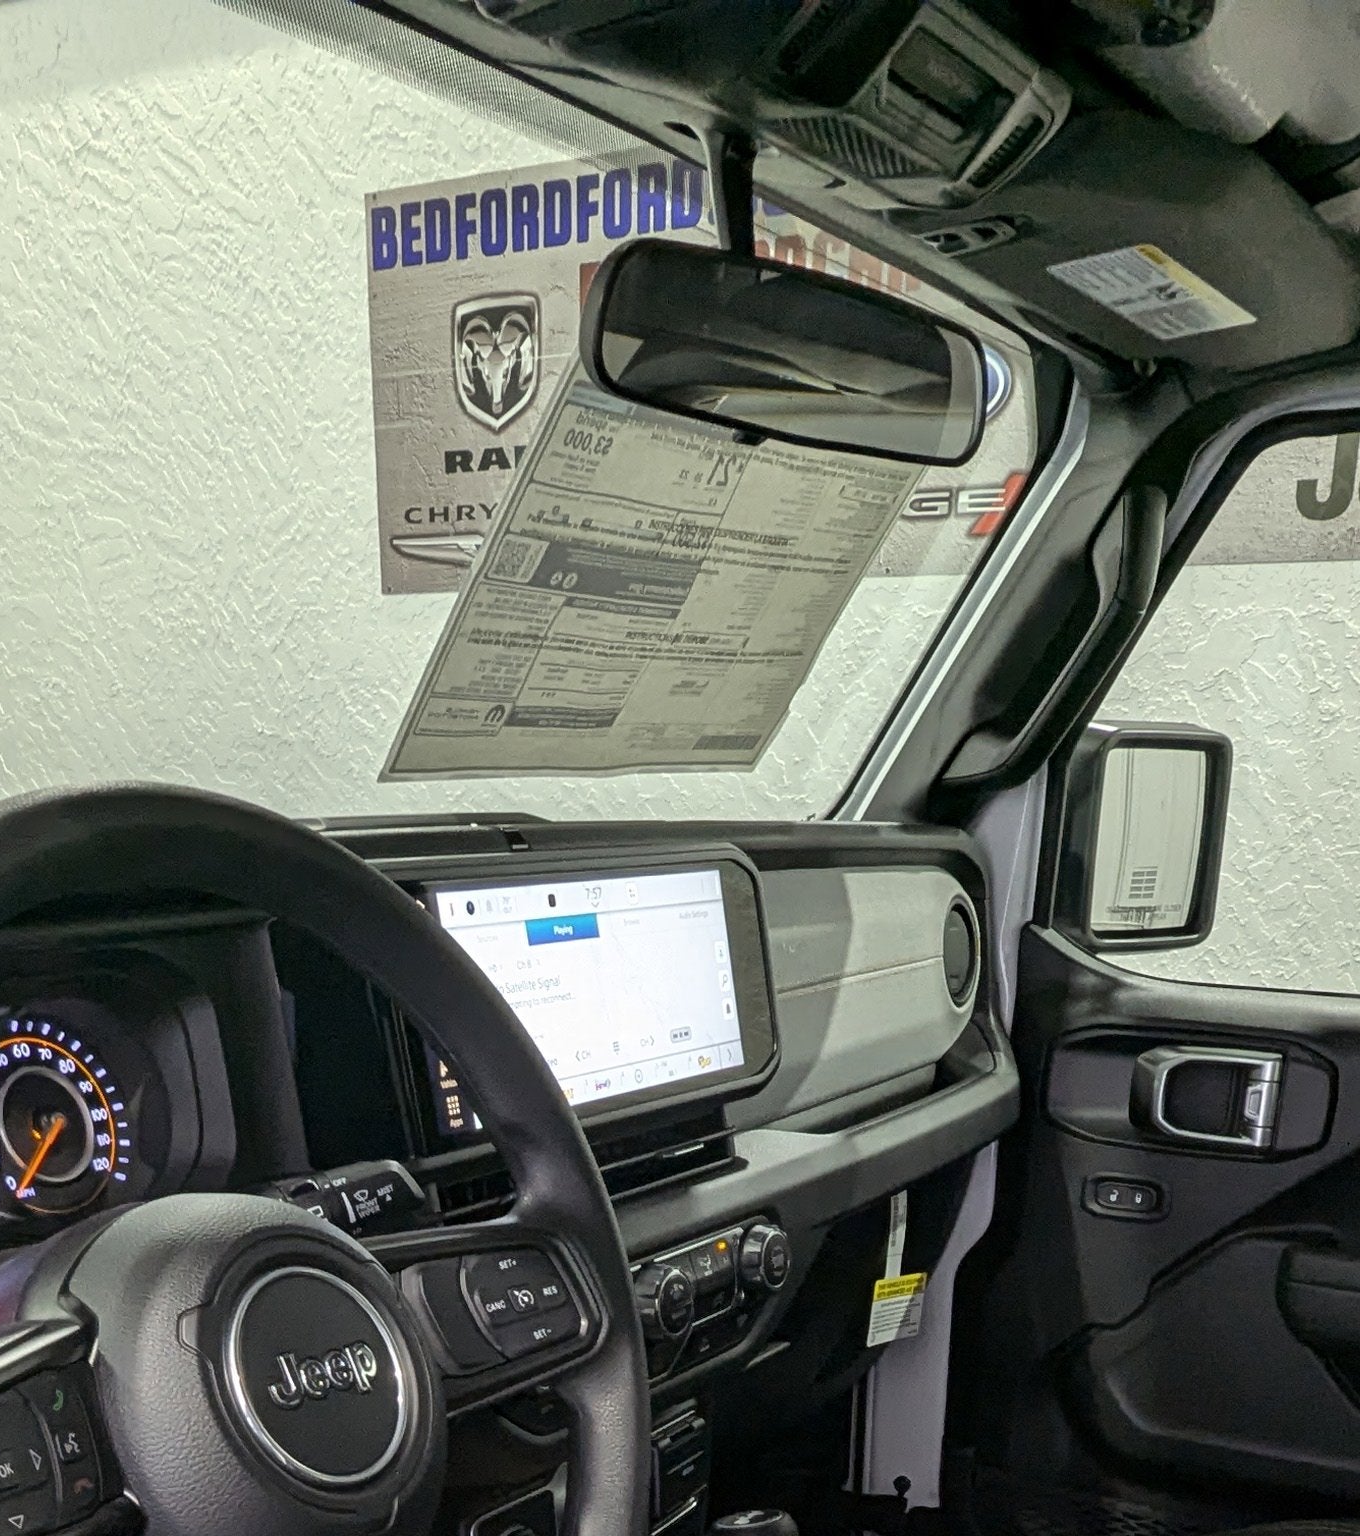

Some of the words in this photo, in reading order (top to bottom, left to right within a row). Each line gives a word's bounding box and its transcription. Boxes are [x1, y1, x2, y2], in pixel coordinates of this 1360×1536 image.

[372, 158, 703, 271] BEDFORDFORD
[902, 487, 1006, 516] GE
[403, 502, 498, 524] CHRY
[552, 924, 574, 937] Playing
[538, 974, 560, 991] Signal
[542, 1285, 558, 1297] RES
[485, 1299, 506, 1313] CANC
[267, 1339, 378, 1411] Jeep
